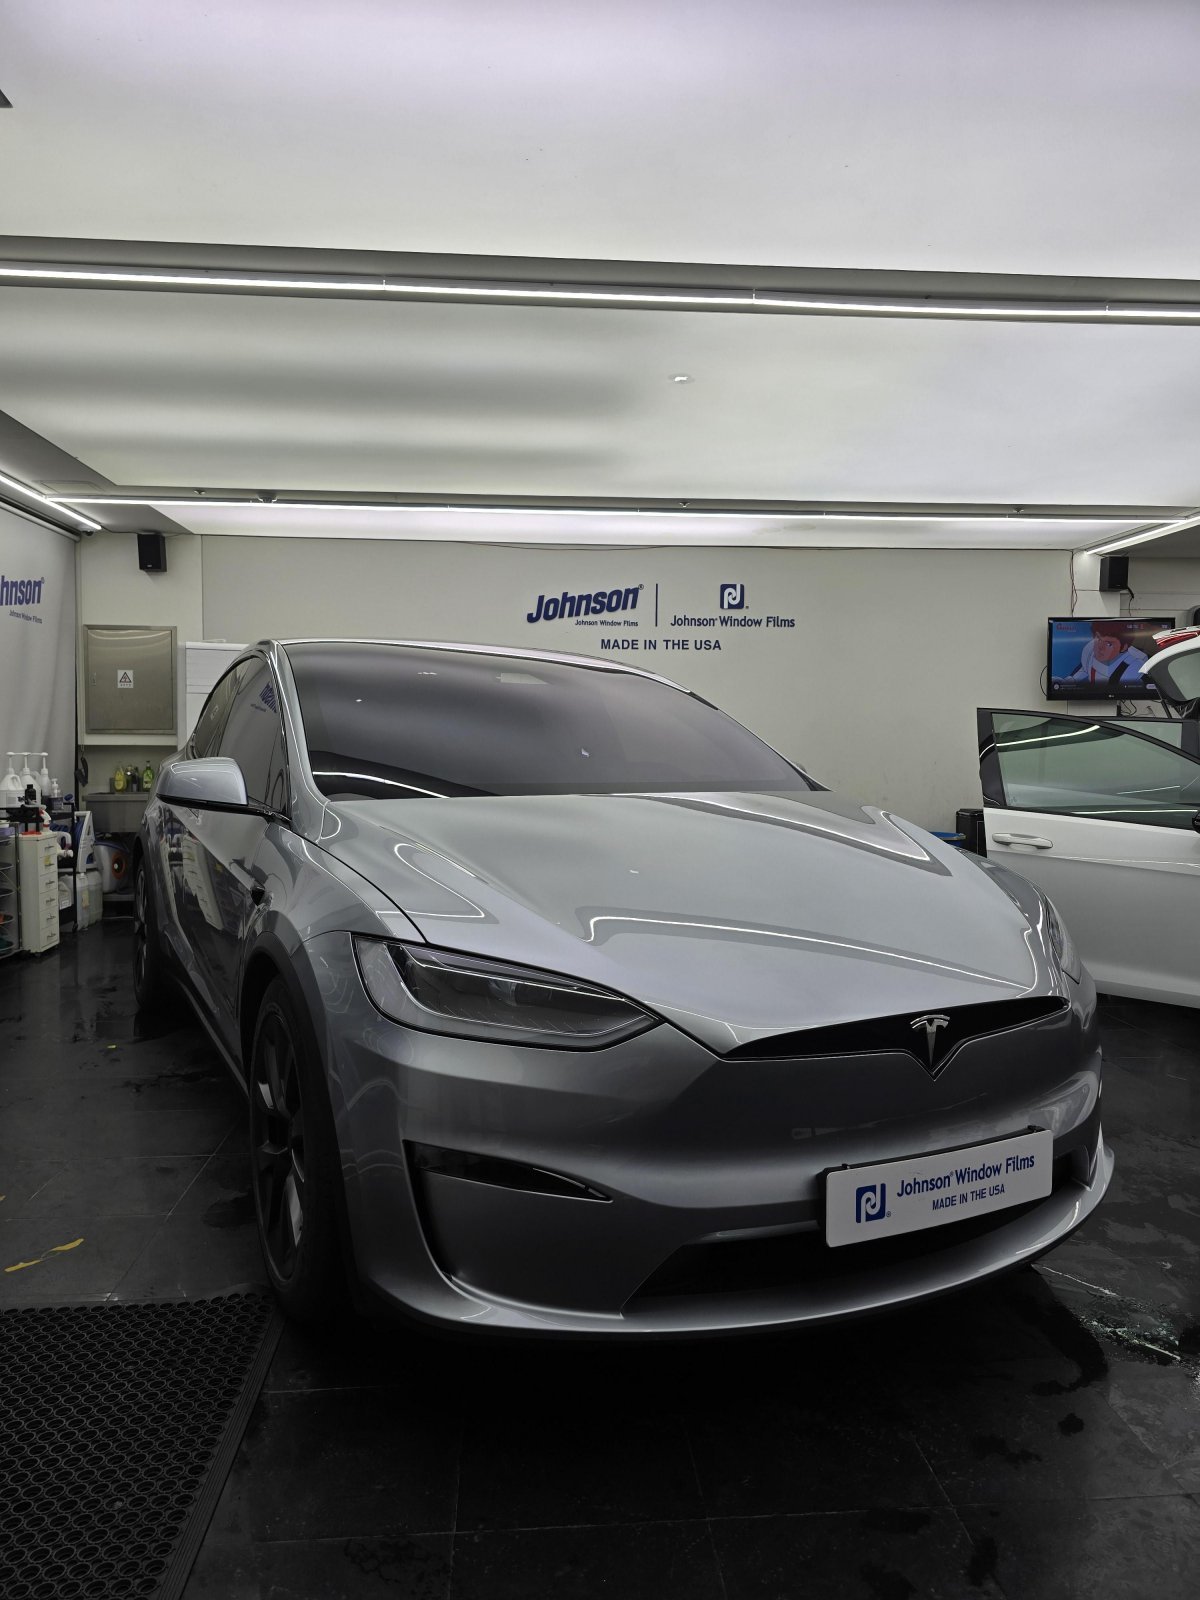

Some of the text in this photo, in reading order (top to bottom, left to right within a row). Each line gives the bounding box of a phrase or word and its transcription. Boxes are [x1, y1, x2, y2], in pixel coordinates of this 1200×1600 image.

[0, 575, 42, 606] hnson
[600, 619, 622, 627] Window
[719, 615, 762, 627] Window
[766, 616, 796, 628] Films
[600, 639, 722, 651] MADE IN THE USA
[954, 1163, 1002, 1186] Window
[1005, 1154, 1035, 1174] Films
[932, 1183, 1005, 1211] MADE IN THE USA
